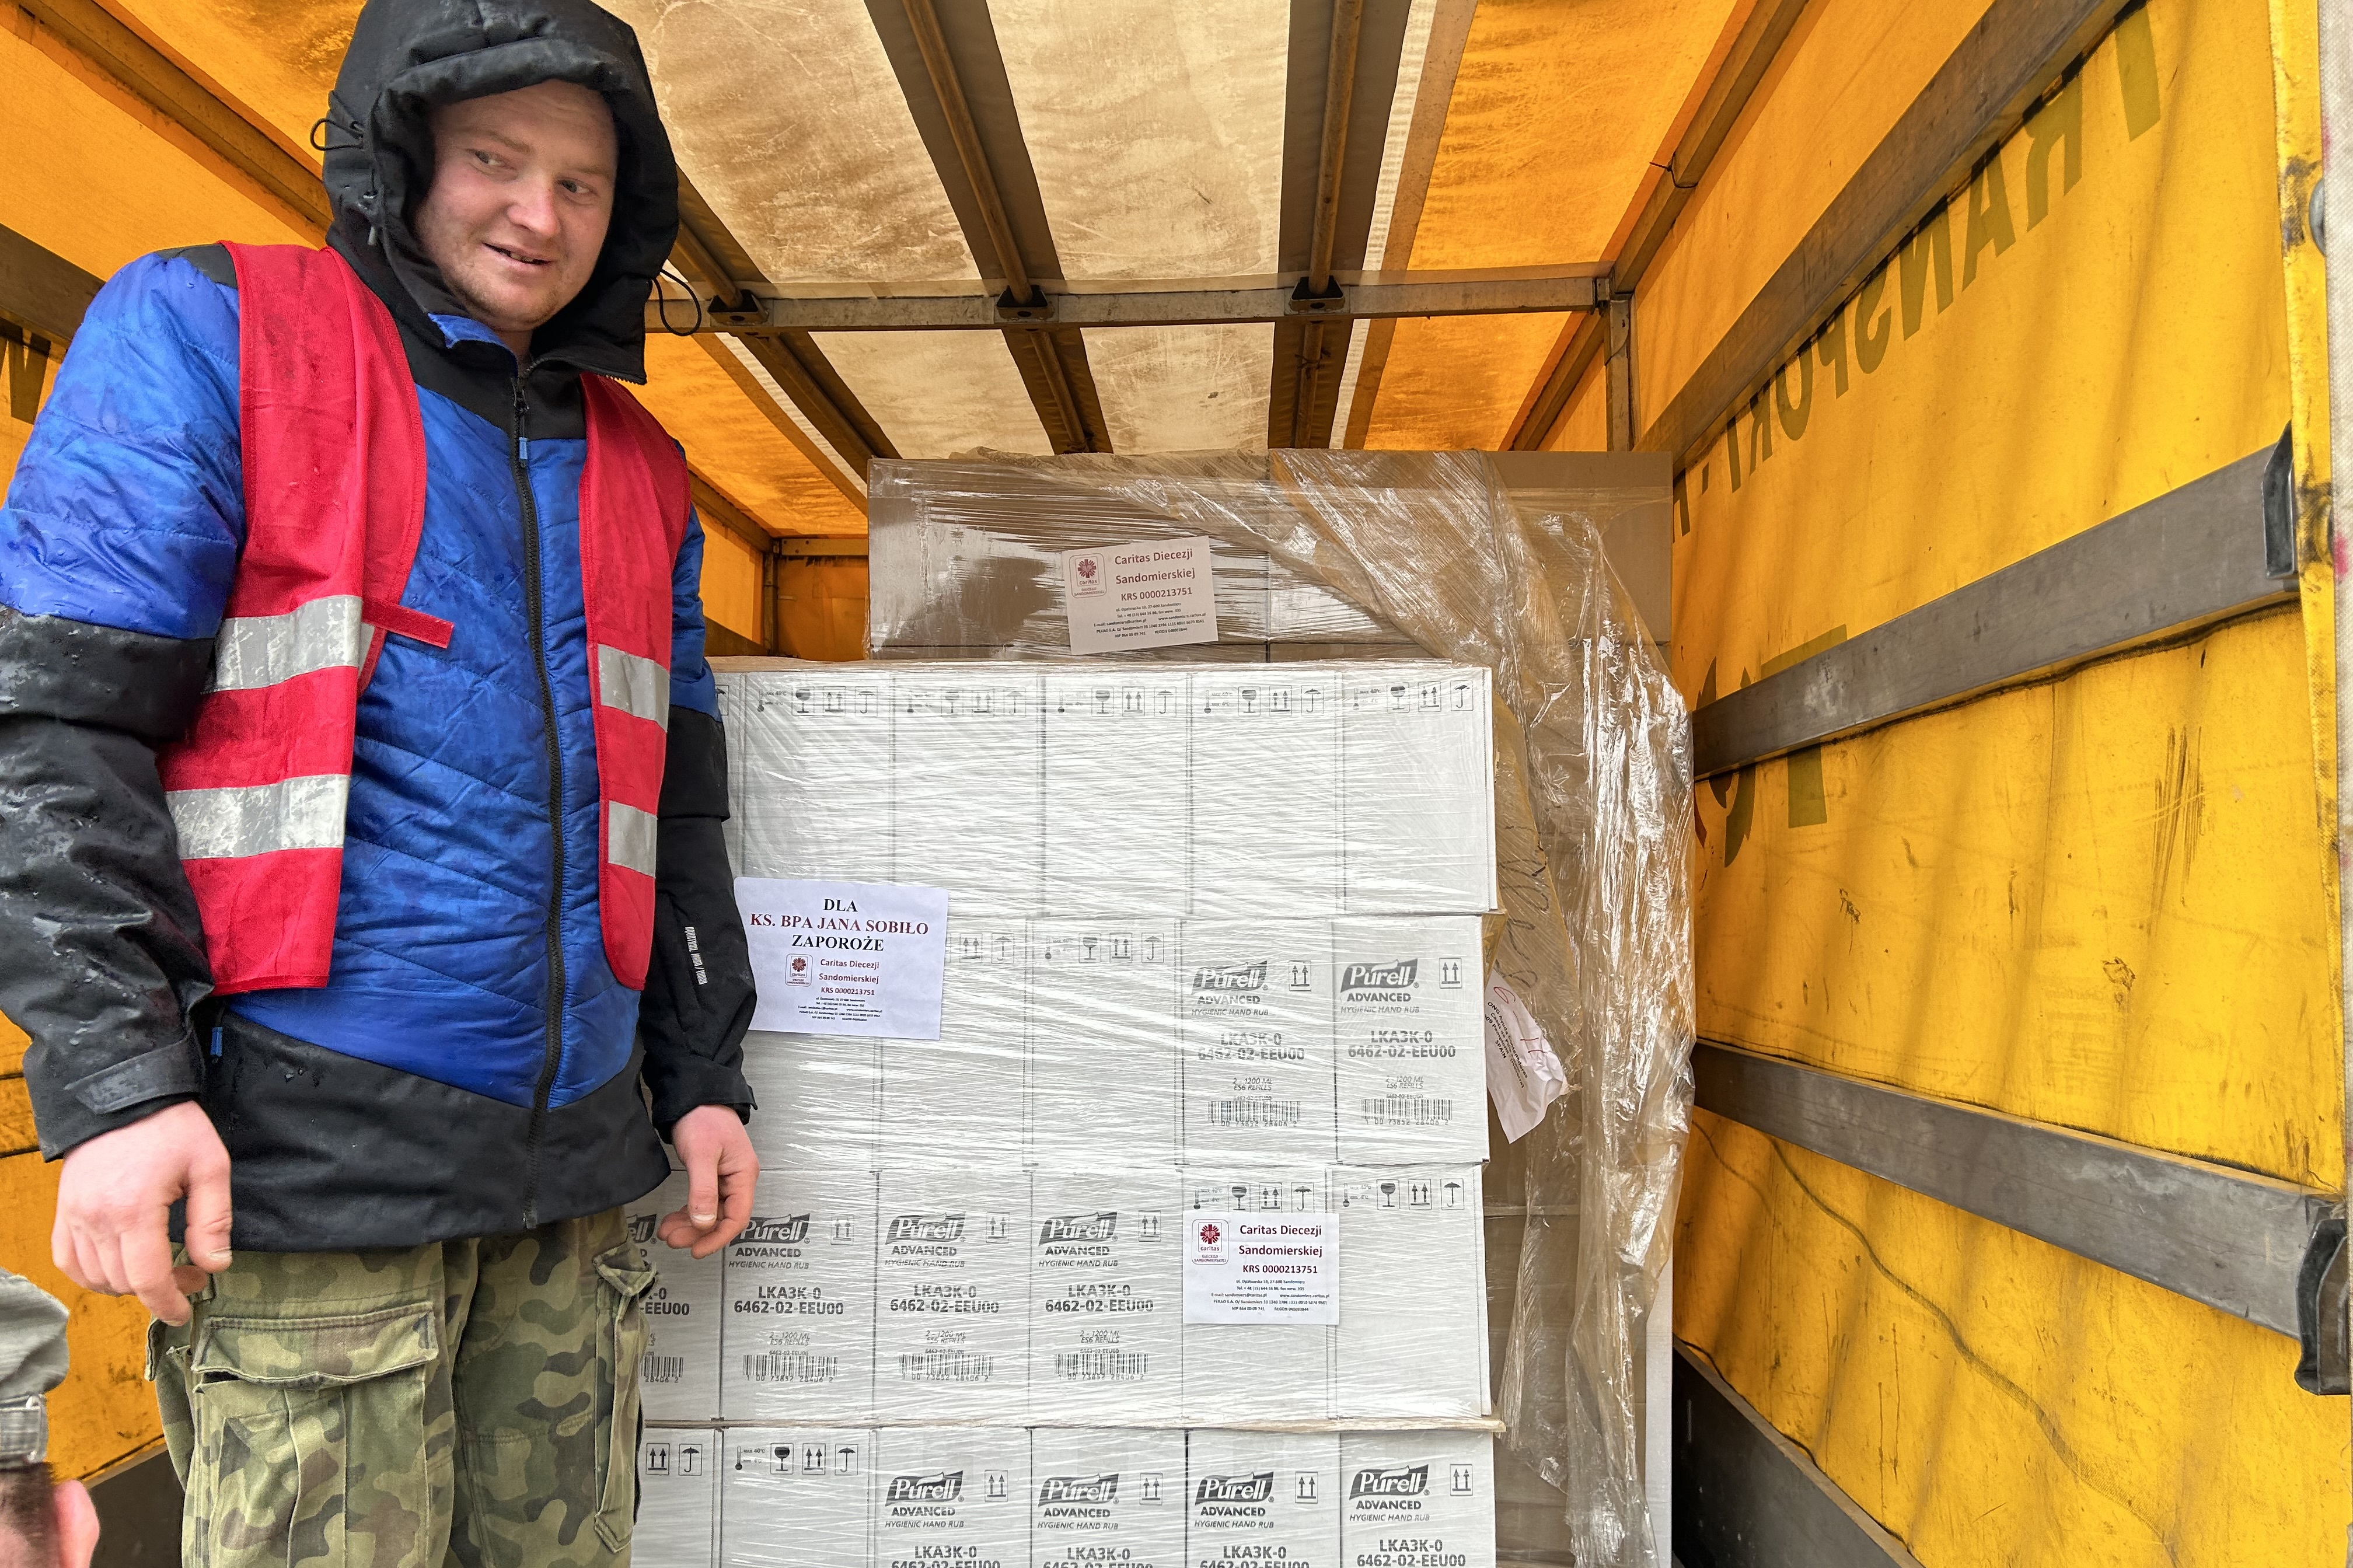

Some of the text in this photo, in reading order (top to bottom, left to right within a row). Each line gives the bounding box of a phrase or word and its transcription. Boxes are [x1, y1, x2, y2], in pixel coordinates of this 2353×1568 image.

[1115, 549, 1193, 565] Caritas Diecezji
[1116, 567, 1195, 584] Sandomierskiej
[1121, 587, 1192, 601] KRS 0000213751
[823, 899, 857, 912] DLA
[750, 914, 928, 935] KS. BPA JANA SOBIŁO
[792, 934, 884, 951] ZAPOROŻE
[821, 959, 879, 969] Caritas Diecezji
[819, 973, 879, 984] Sandomierskiej
[1199, 968, 1261, 988] Purell
[1347, 965, 1412, 986] Purell
[835, 987, 875, 996] 0000213751
[1347, 993, 1411, 1002] ADVANCED
[1197, 996, 1261, 1004] ADVANCED
[1488, 1001, 1500, 1014] ONG
[1371, 1031, 1432, 1043] LKA3K-0
[1349, 1045, 1455, 1057] 6462-02-EEU00
[1495, 1039, 1507, 1059] SPAIN
[739, 1219, 803, 1241] Purell
[891, 1218, 959, 1240] Purell
[1045, 1217, 1112, 1239] Purell
[1240, 1225, 1322, 1237] Caritas Diecezji
[735, 1248, 801, 1258] ADVANCED
[891, 1245, 957, 1256] ADVANCED
[1045, 1246, 1110, 1255] ADVANCED
[1239, 1245, 1322, 1258] Sandomierskiej
[1243, 1265, 1318, 1273] KRS 0000213751
[758, 1286, 821, 1300] LKA3K-0
[914, 1284, 977, 1298] LKA3K-0
[1069, 1284, 1130, 1297] LKA3K-0
[734, 1300, 844, 1315] 6462-02-EEU00
[890, 1299, 999, 1313] 6462-02-EEU00
[1045, 1300, 1153, 1312] 6462-02-EEU00
[1358, 1471, 1422, 1493] Purell
[892, 1478, 957, 1500] Purell
[1045, 1479, 1113, 1502] Purell
[1201, 1478, 1267, 1500] Purell
[892, 1507, 955, 1516] ADVANCED
[1356, 1500, 1421, 1510] ADVANCED
[1043, 1508, 1111, 1517] ADVANCED
[1200, 1507, 1266, 1517] ADVANCED
[914, 1546, 977, 1558] LKA3K-0
[1380, 1539, 1443, 1552] LKA3K-0
[1067, 1548, 1130, 1562] LKA3K-0
[1223, 1546, 1286, 1559] LKA3K-0
[1357, 1555, 1466, 1567] 6462-02-EEU00
